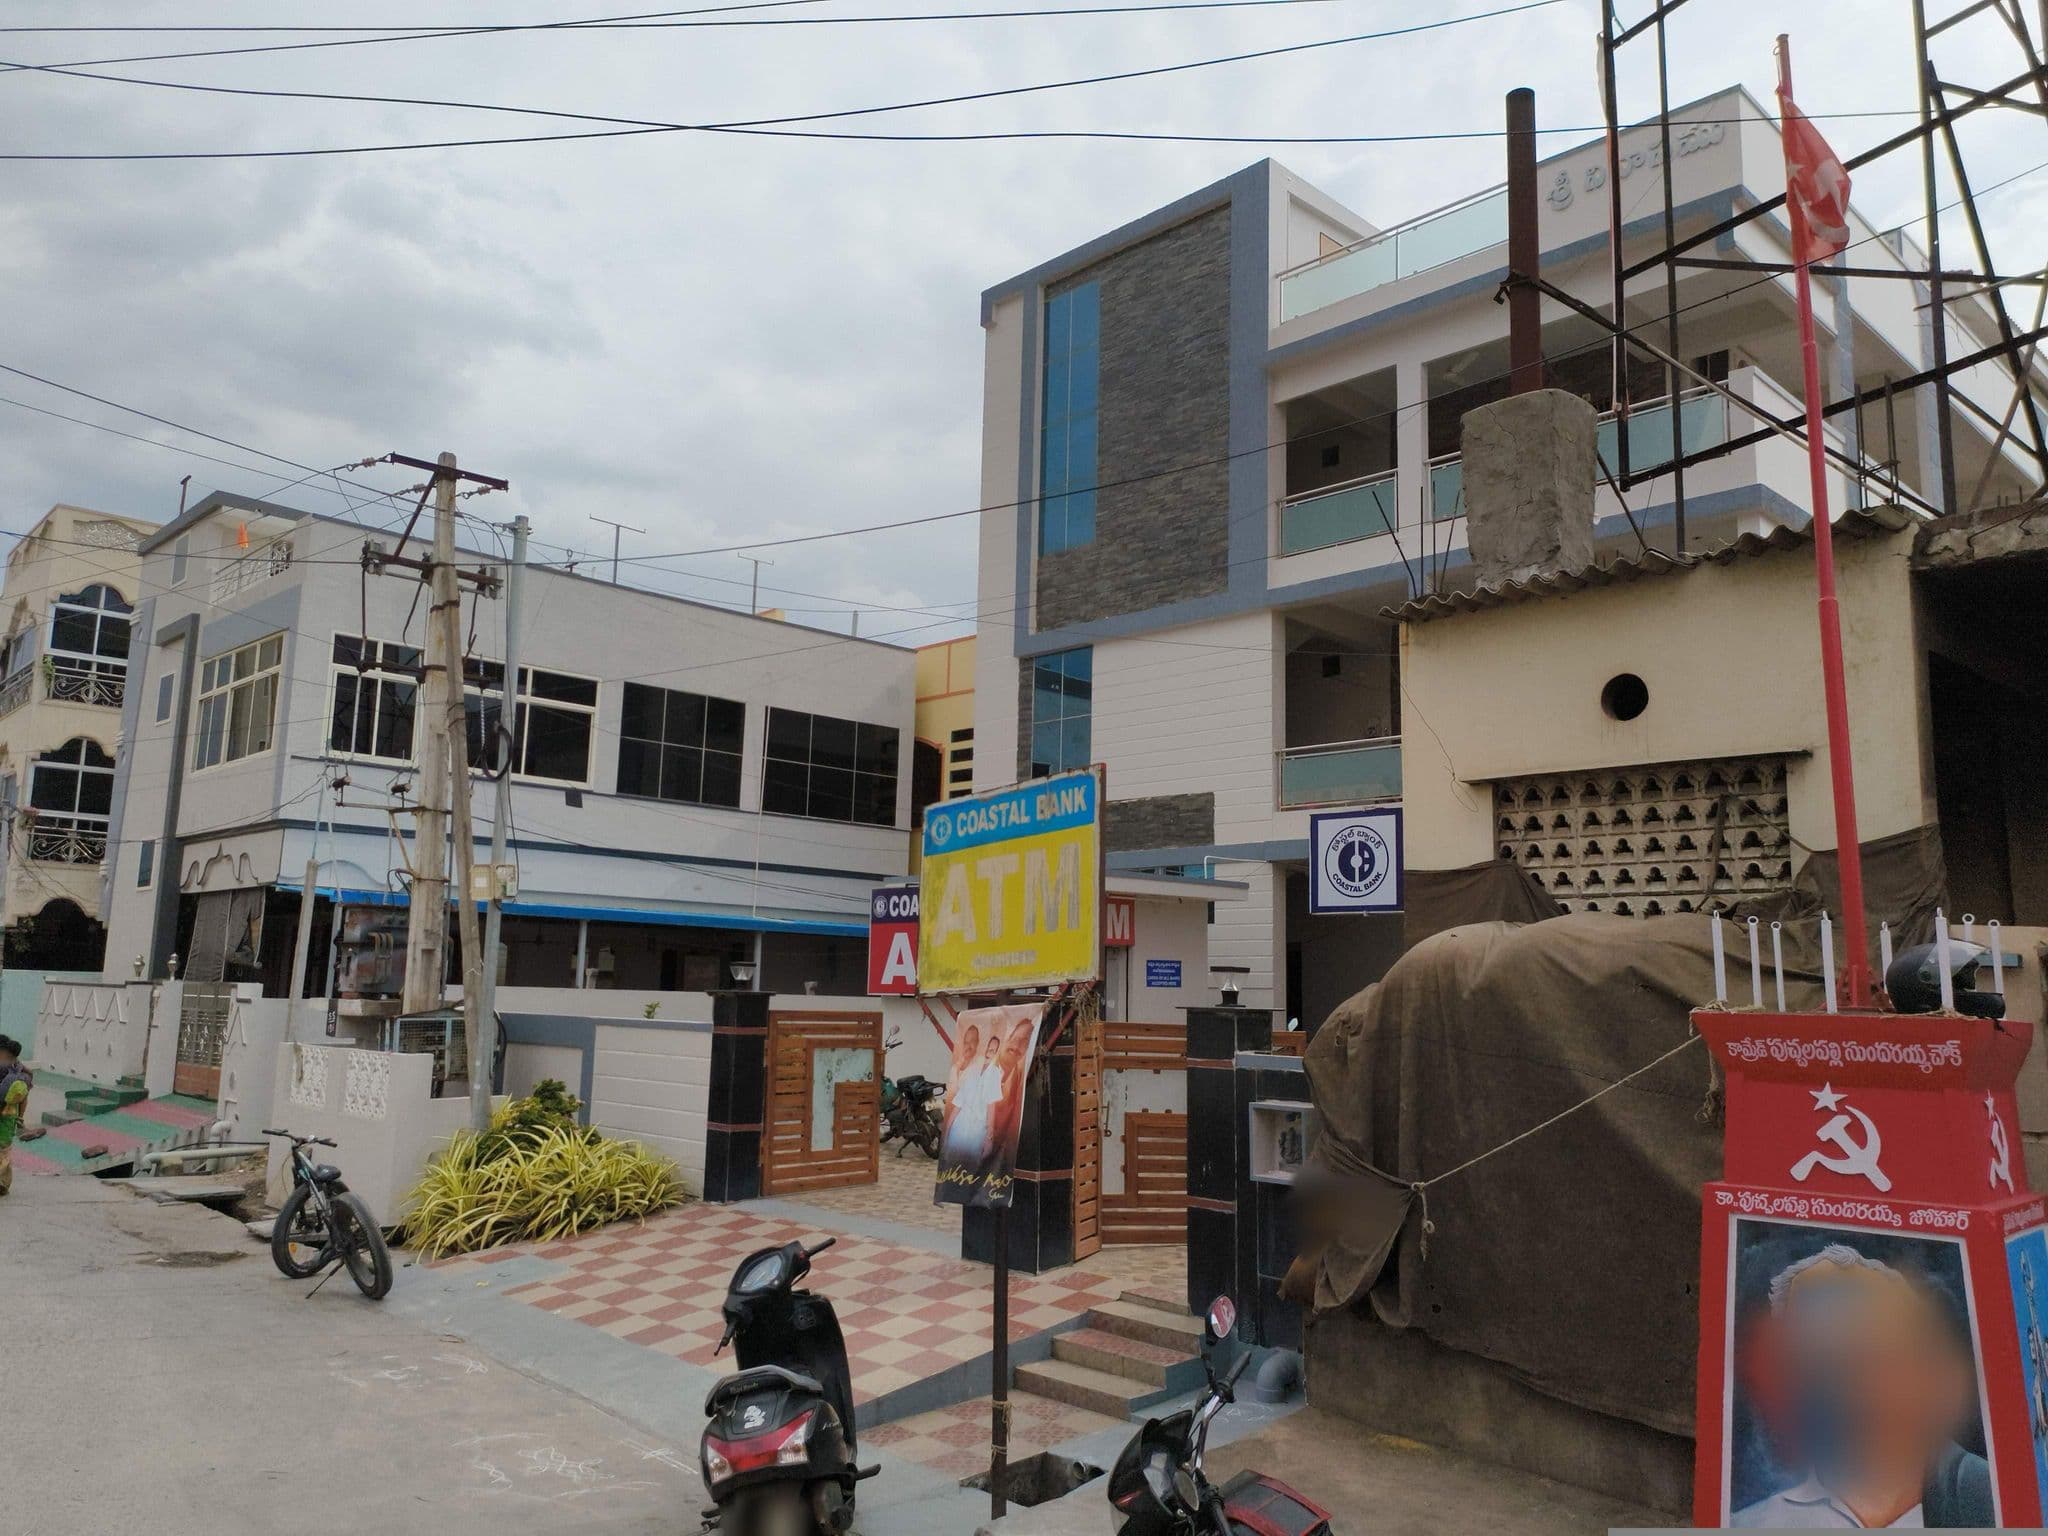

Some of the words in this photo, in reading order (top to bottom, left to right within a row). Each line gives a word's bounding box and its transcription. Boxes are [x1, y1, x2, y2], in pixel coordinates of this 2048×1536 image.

[957, 799, 1031, 837] COASTAL
[1036, 784, 1088, 821] BANK
[931, 842, 1080, 947] ATM
[1332, 873, 1363, 893] COASTAL
[1364, 871, 1383, 890] BANK
